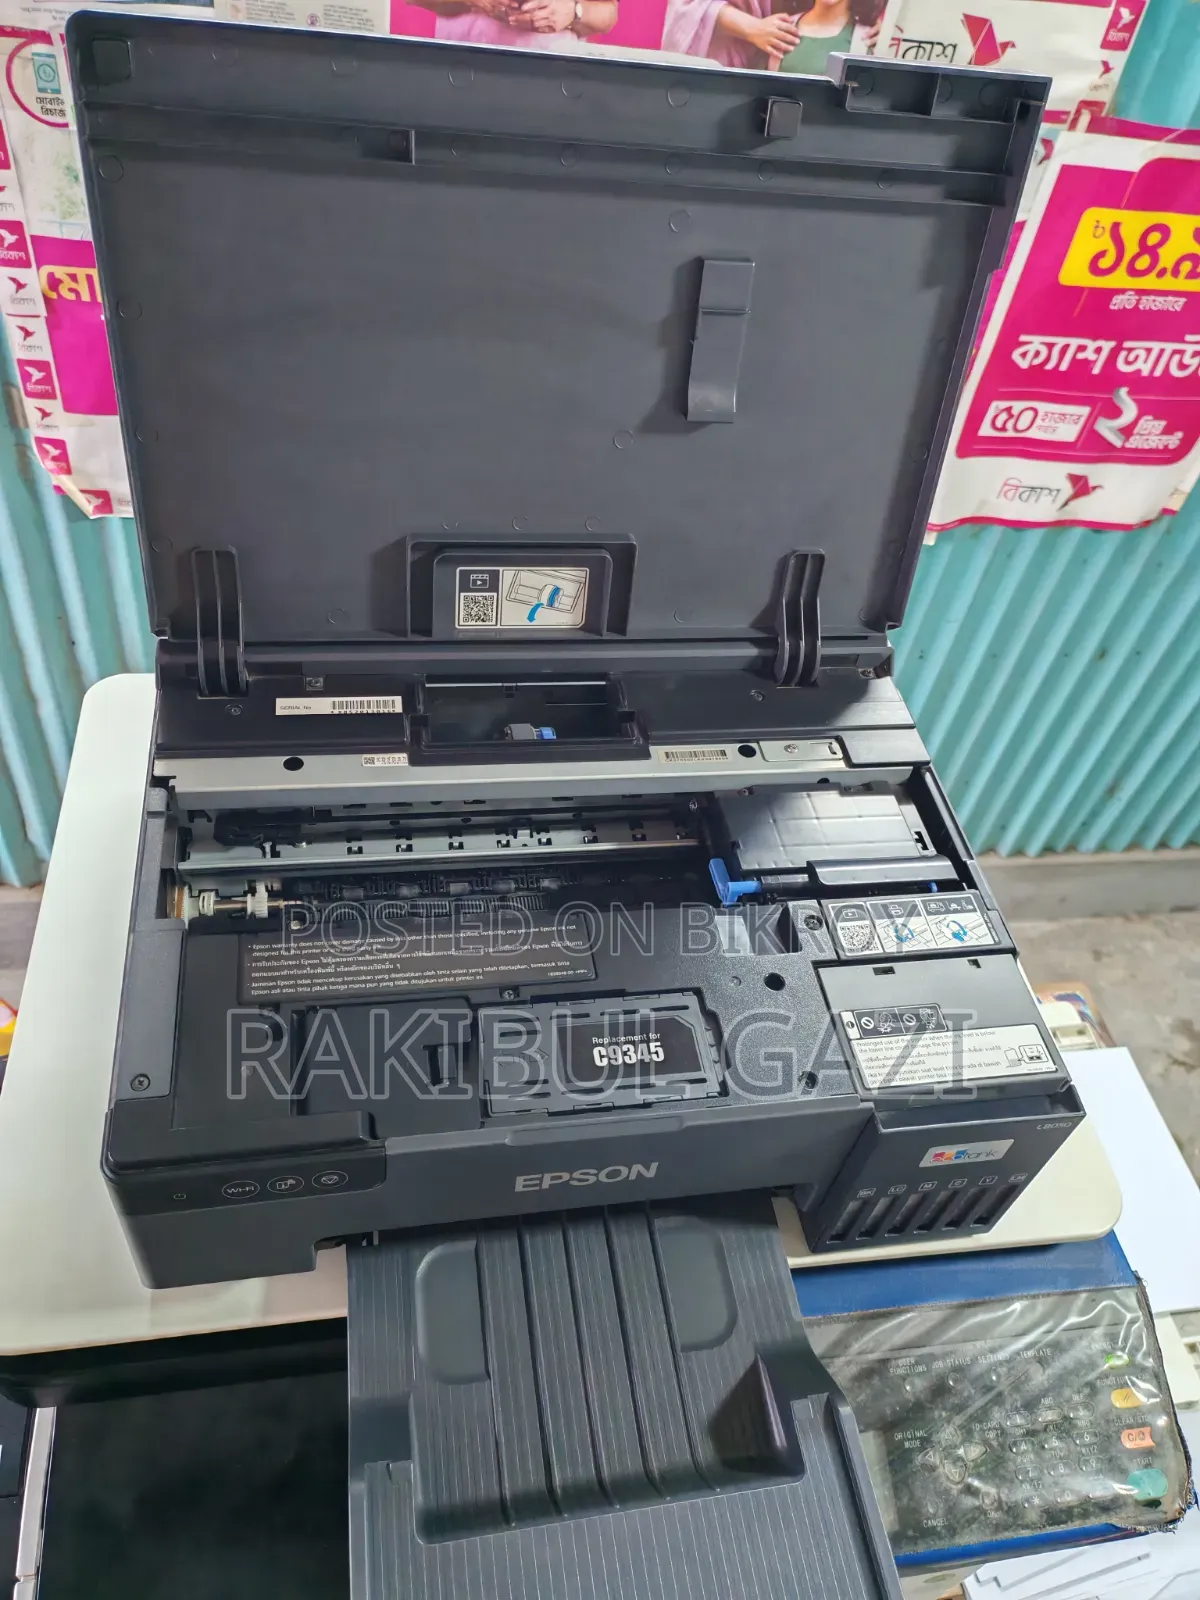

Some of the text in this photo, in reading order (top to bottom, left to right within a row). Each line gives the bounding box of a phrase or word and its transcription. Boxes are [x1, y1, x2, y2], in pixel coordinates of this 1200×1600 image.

[1011, 334, 1200, 378] ক্যাশ আউ
[1094, 386, 1138, 448] ২
[997, 477, 1062, 504] বিকাশ
[252, 950, 279, 958] designed
[301, 948, 321, 956] printer
[592, 1032, 661, 1045] Replacement for
[592, 1042, 665, 1067] C9345
[1037, 1122, 1073, 1130] L8050
[514, 1162, 659, 1192] EPSON
[1020, 1348, 1052, 1359] TEMPLATE
[947, 1358, 971, 1367] STATUS
[889, 1364, 927, 1375] FUNCTIONS
[1097, 1376, 1128, 1388] FUNCTIO
[1114, 1414, 1150, 1426] CLEAR/STO
[894, 1430, 927, 1441] ORIGINAL
[1084, 1432, 1090, 1441] 6
[904, 1438, 921, 1448] MODE
[1021, 1441, 1027, 1450] 4
[1052, 1436, 1058, 1446] 5
[1090, 1459, 1096, 1468] 9
[1133, 1457, 1152, 1467] START
[1058, 1463, 1064, 1473] 8
[922, 1518, 949, 1528] CANCEL
